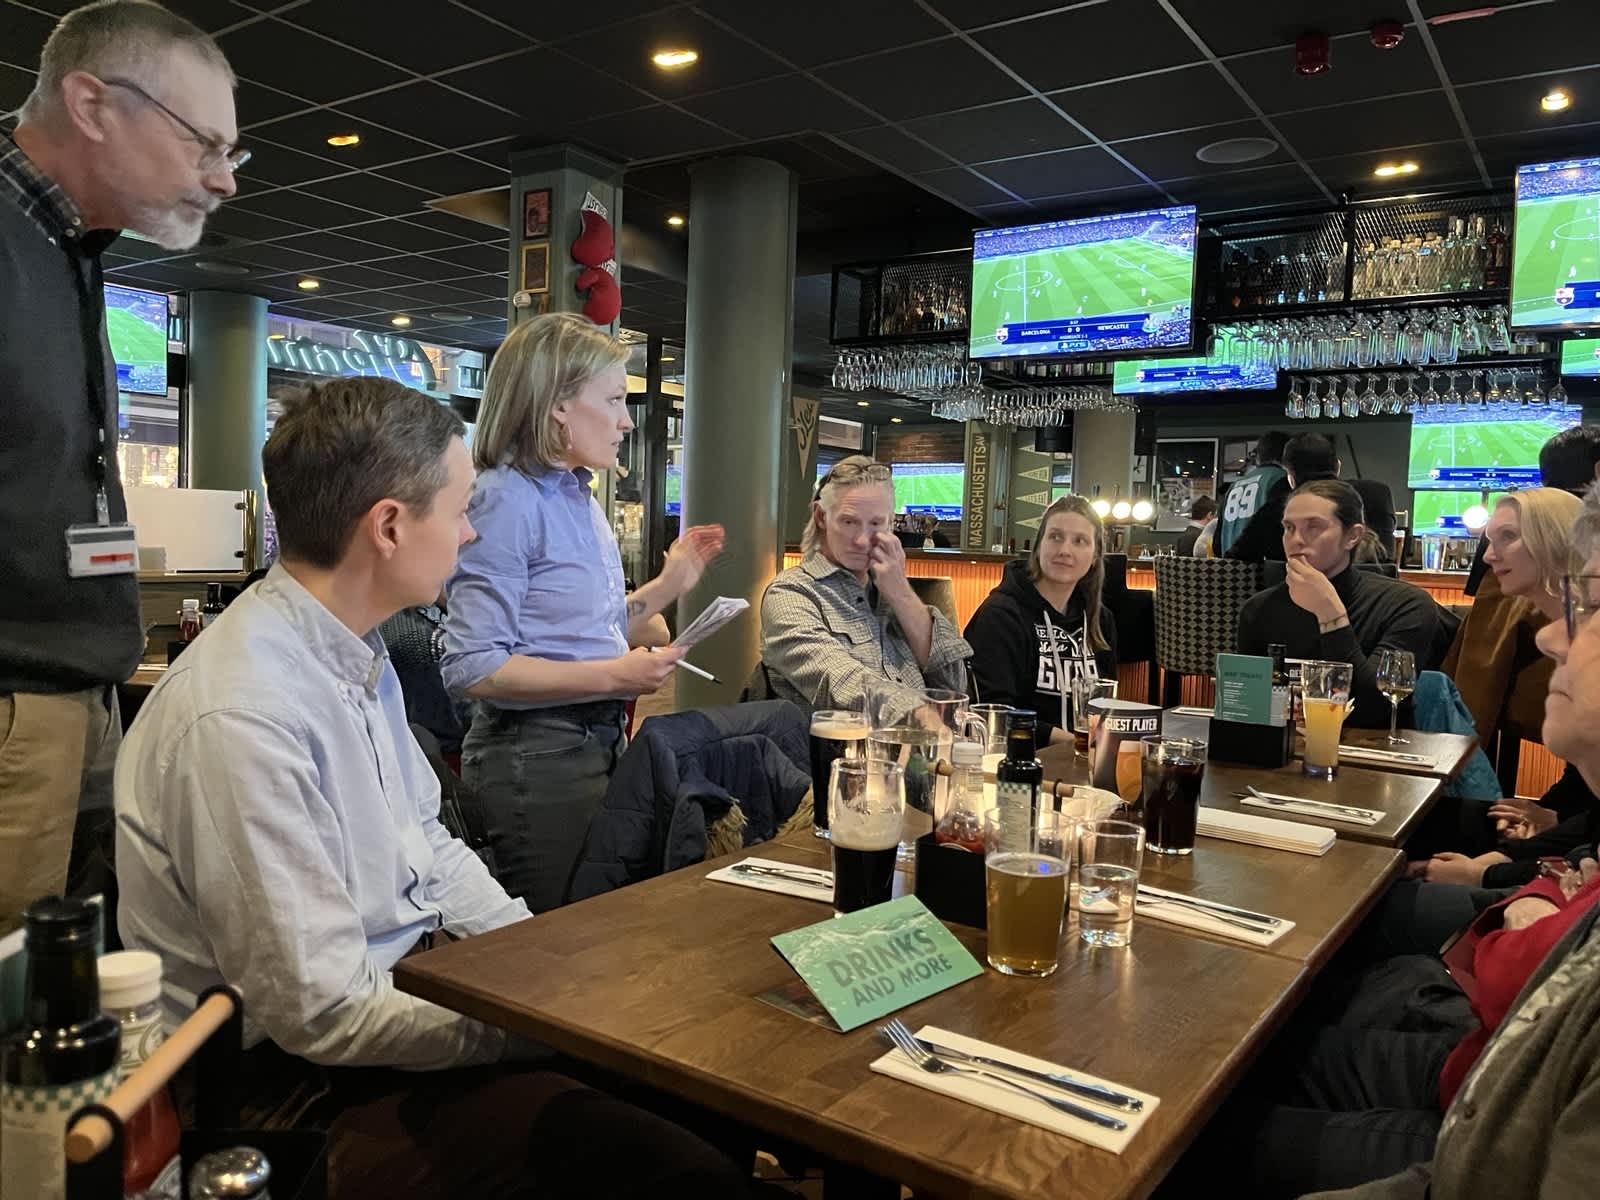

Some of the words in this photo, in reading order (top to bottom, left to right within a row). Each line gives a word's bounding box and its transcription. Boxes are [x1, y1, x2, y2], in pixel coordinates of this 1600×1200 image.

[969, 445, 986, 547] MASSACHUSETTS
[1224, 482, 1259, 522] 89
[1104, 717, 1132, 732] GUEST
[1132, 718, 1158, 732] PLAYER
[826, 929, 938, 989] DRINKS
[851, 975, 896, 1008] AND
[901, 953, 953, 989] MORE
